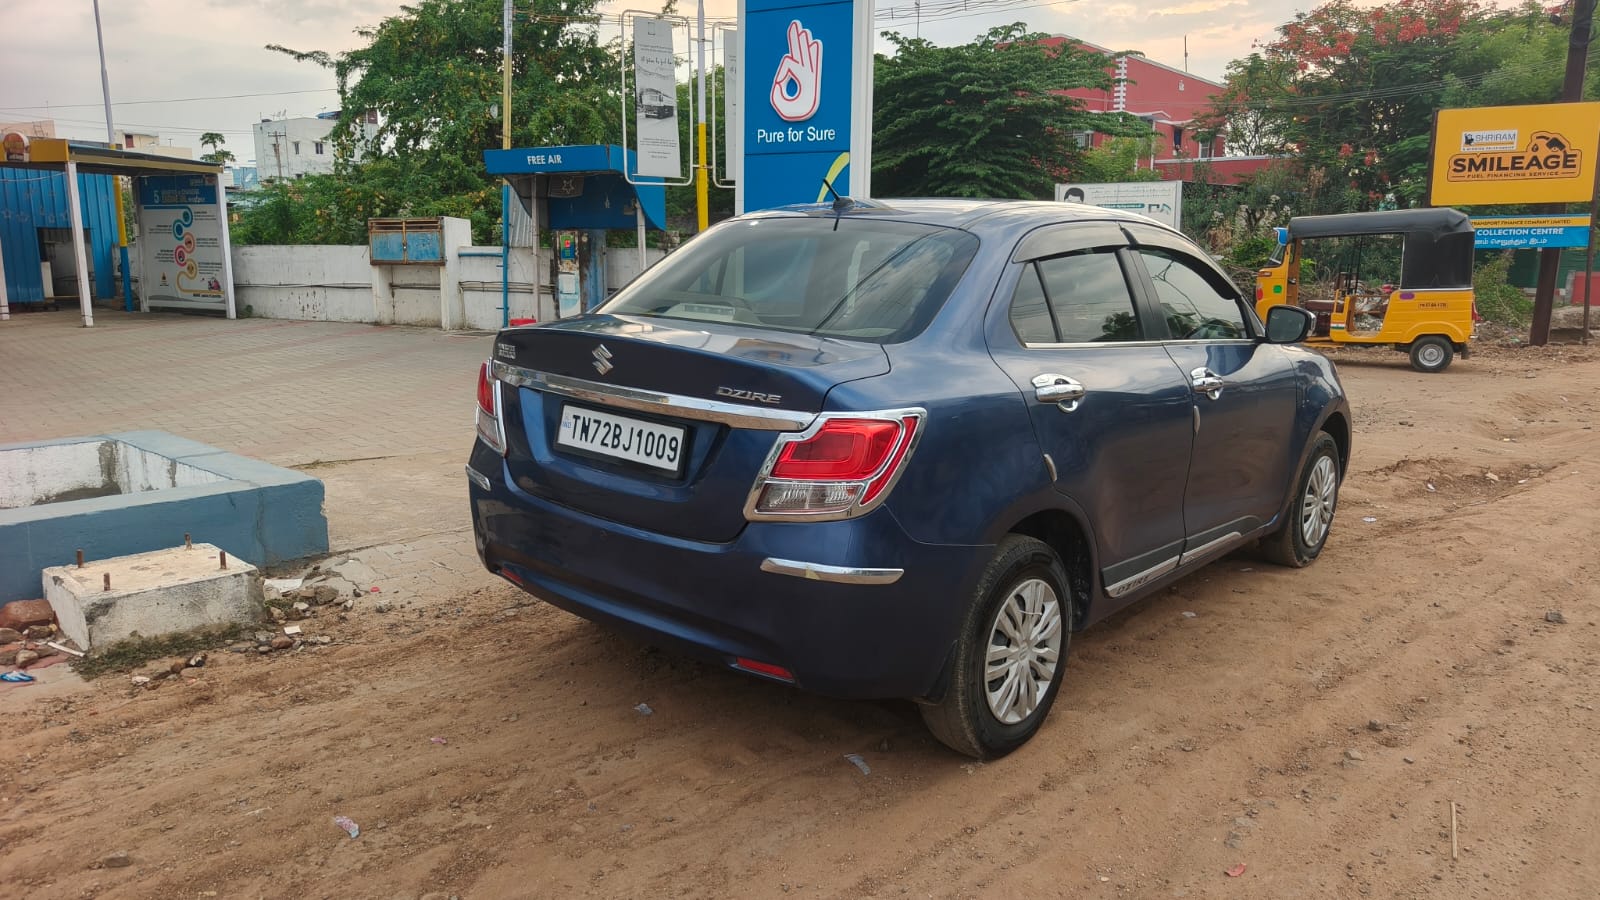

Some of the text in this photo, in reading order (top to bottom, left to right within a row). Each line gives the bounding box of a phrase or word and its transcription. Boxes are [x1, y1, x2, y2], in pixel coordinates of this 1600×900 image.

[757, 126, 836, 144] Pure for Sure
[526, 154, 562, 165] FREE AIR
[1452, 153, 1578, 173] SMILEAGE
[1476, 227, 1564, 236] COLLECTION CENTRE
[716, 386, 782, 404] DZIRE
[572, 414, 680, 463] TN72BJ1009
